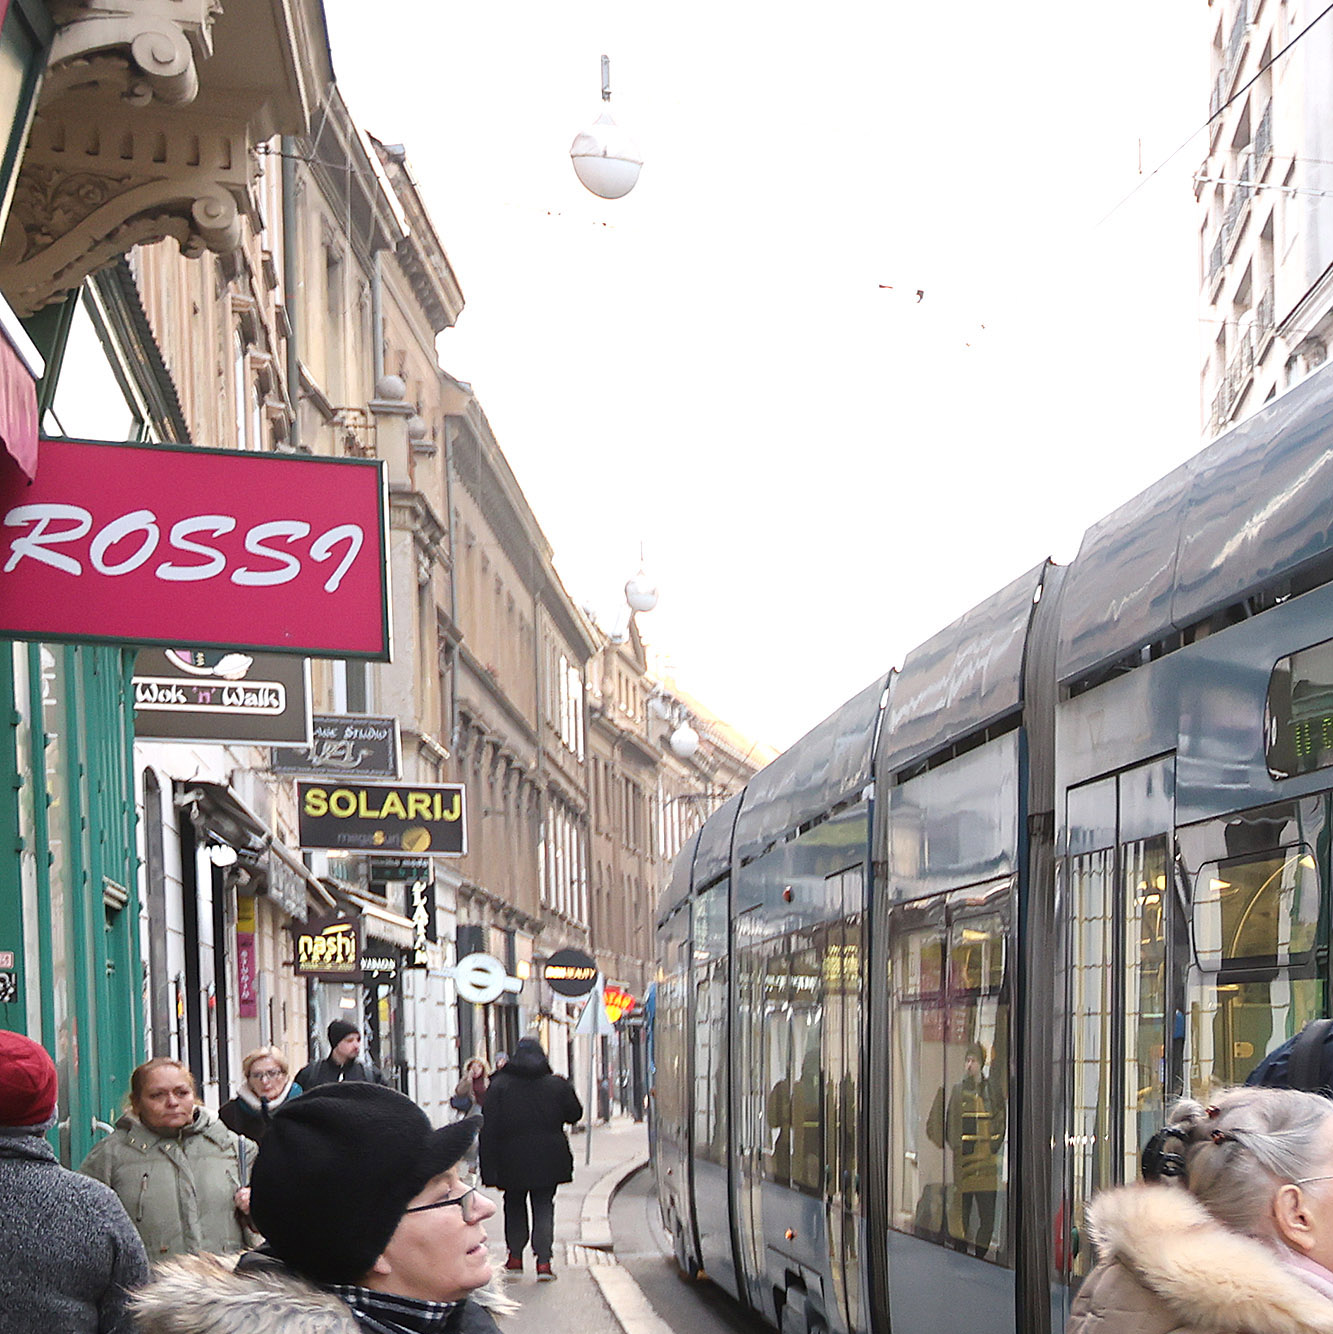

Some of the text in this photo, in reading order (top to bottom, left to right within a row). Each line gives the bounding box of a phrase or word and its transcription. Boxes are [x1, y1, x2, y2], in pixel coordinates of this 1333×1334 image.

[3, 503, 365, 594] ROSSI
[135, 682, 187, 705] Wok
[222, 686, 281, 708] Walk
[303, 787, 461, 822] SOLARIJ
[298, 930, 356, 956] nashi
